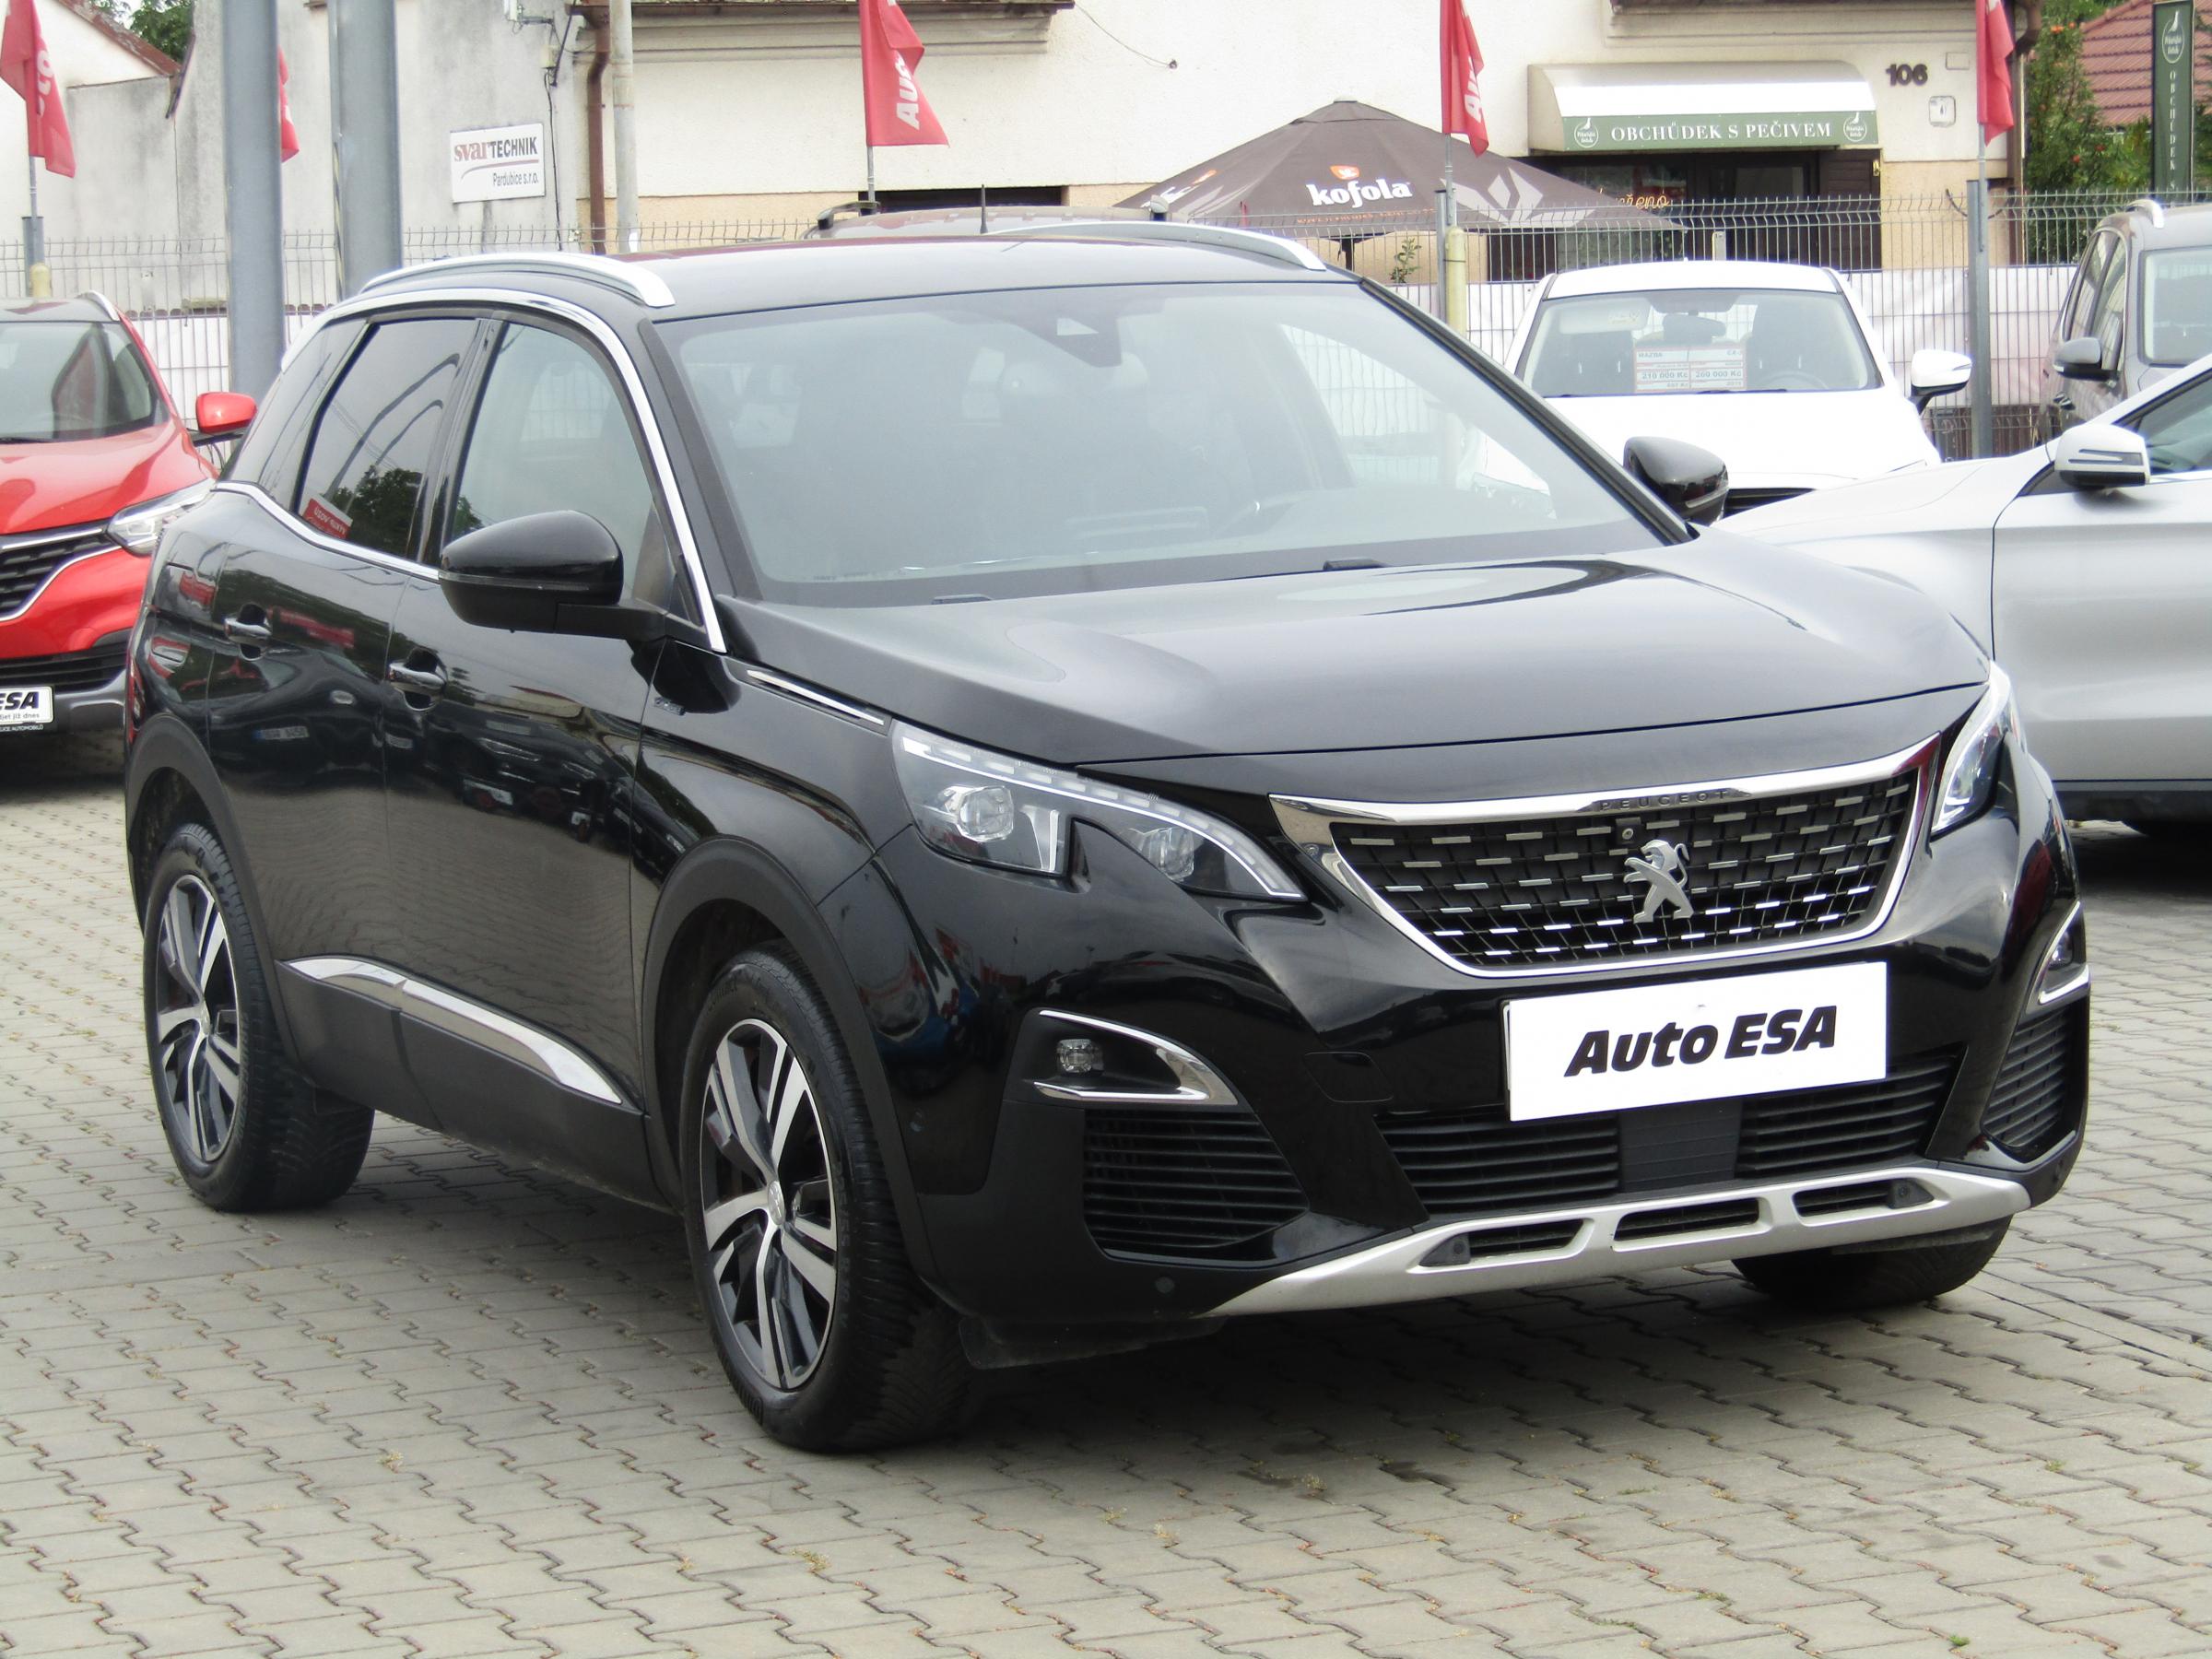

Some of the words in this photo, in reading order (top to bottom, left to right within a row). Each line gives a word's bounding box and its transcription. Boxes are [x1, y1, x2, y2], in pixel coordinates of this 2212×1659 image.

[1886, 64, 1928, 87] 106
[1611, 121, 1723, 142] OBCHŮDEK
[1728, 124, 1738, 138] S
[1746, 120, 1830, 138] PEČIVEM
[493, 171, 523, 186] Pardubice
[524, 172, 539, 185] s.r.o.
[1306, 179, 1413, 208] kofola
[1599, 790, 1728, 811] PEUGEOT
[1564, 1022, 1719, 1077] Auto
[1724, 1006, 1838, 1059] ESA
